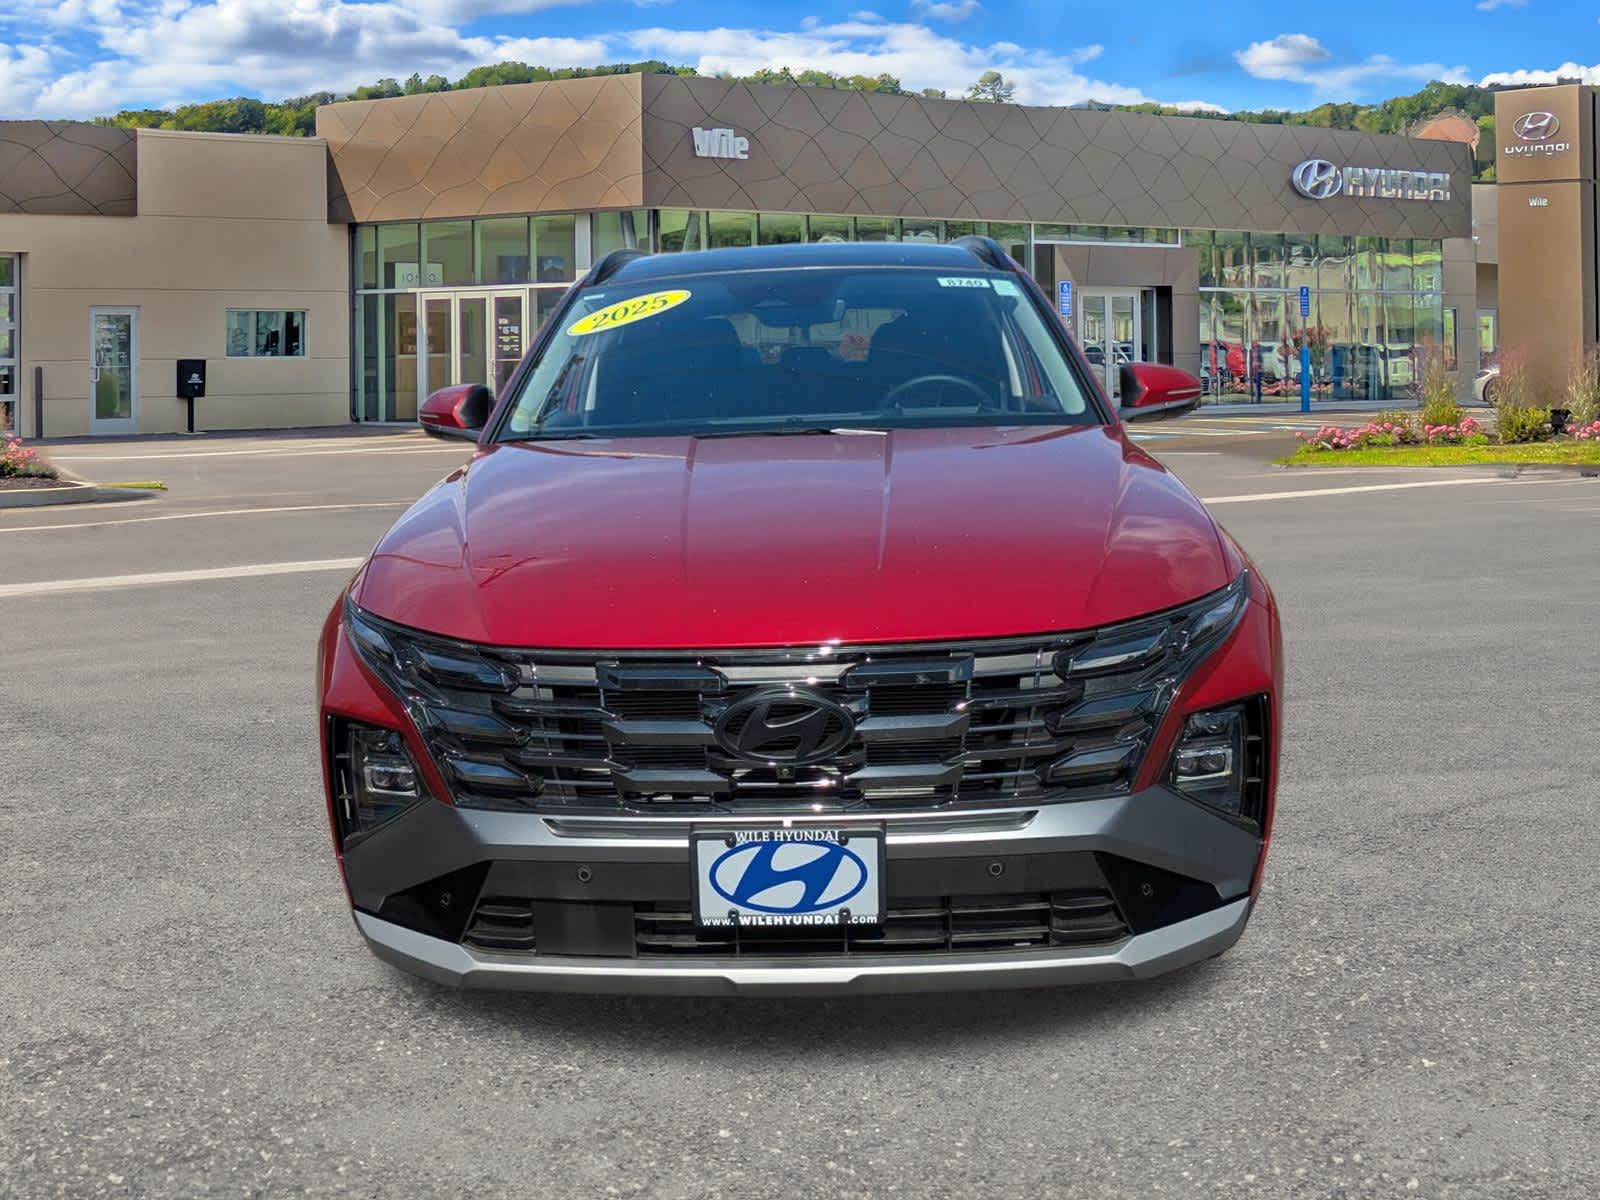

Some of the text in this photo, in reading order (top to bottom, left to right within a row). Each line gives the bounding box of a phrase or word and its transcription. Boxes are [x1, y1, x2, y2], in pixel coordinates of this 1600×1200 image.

[692, 127, 749, 159] Wile
[1343, 167, 1451, 200] HYUNDAI
[592, 295, 668, 329] 2025
[734, 830, 840, 842] WILE HYUNDAI
[739, 914, 840, 926] WILEHYUNDAI
